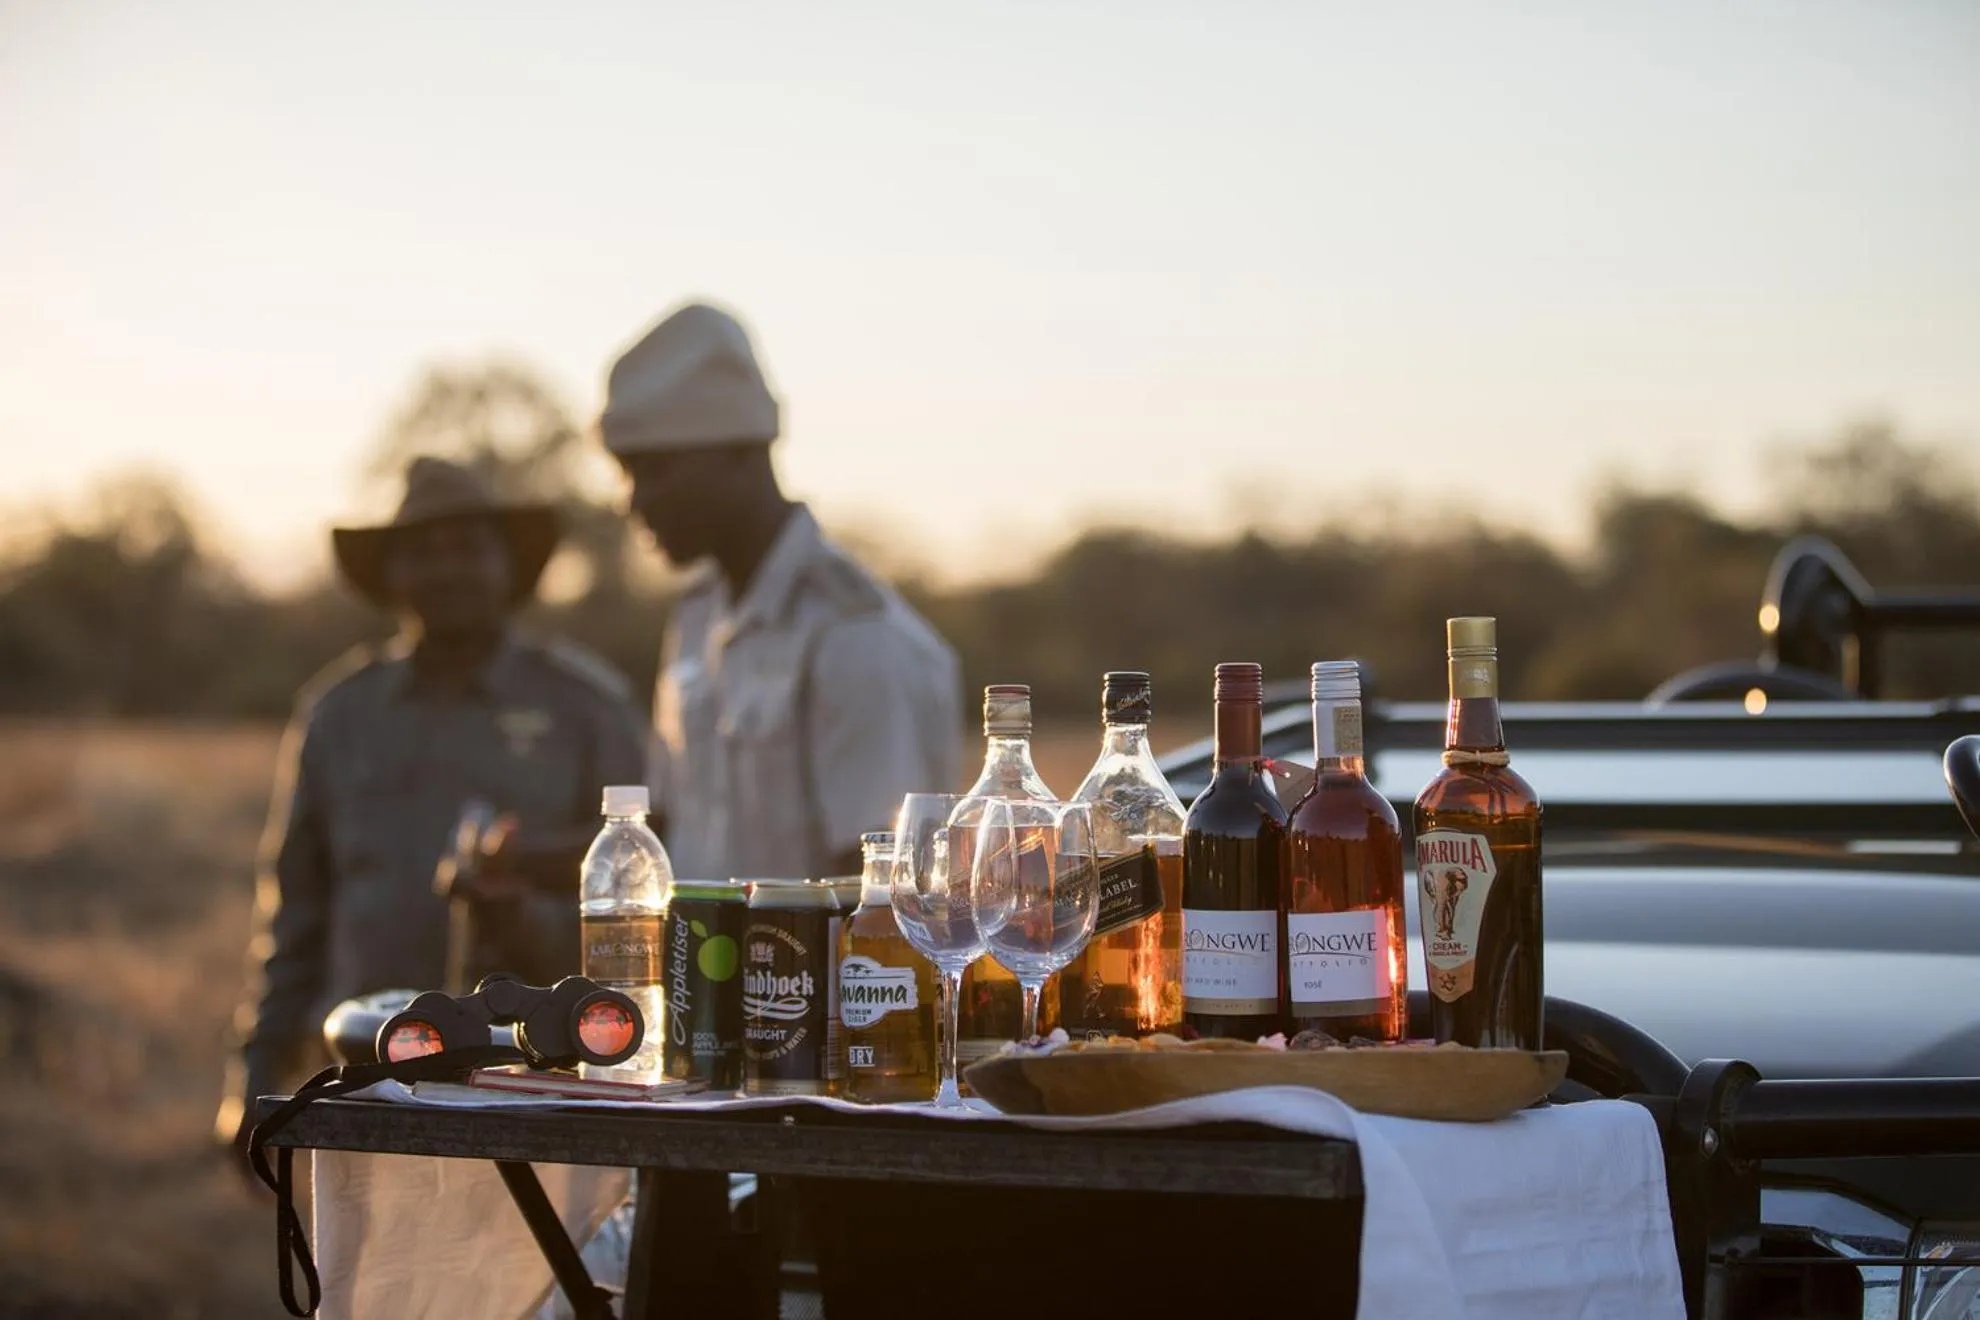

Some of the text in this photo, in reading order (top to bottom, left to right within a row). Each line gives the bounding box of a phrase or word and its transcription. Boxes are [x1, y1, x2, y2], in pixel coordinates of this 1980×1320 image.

[1099, 878, 1138, 901] LABEL
[1184, 928, 1271, 952] RONGWE
[1289, 931, 1378, 955] RONGWE
[668, 911, 692, 1046] Appletiser
[743, 967, 815, 1003] indhoek
[840, 984, 907, 1004] avanna
[850, 1048, 874, 1064] DRY
